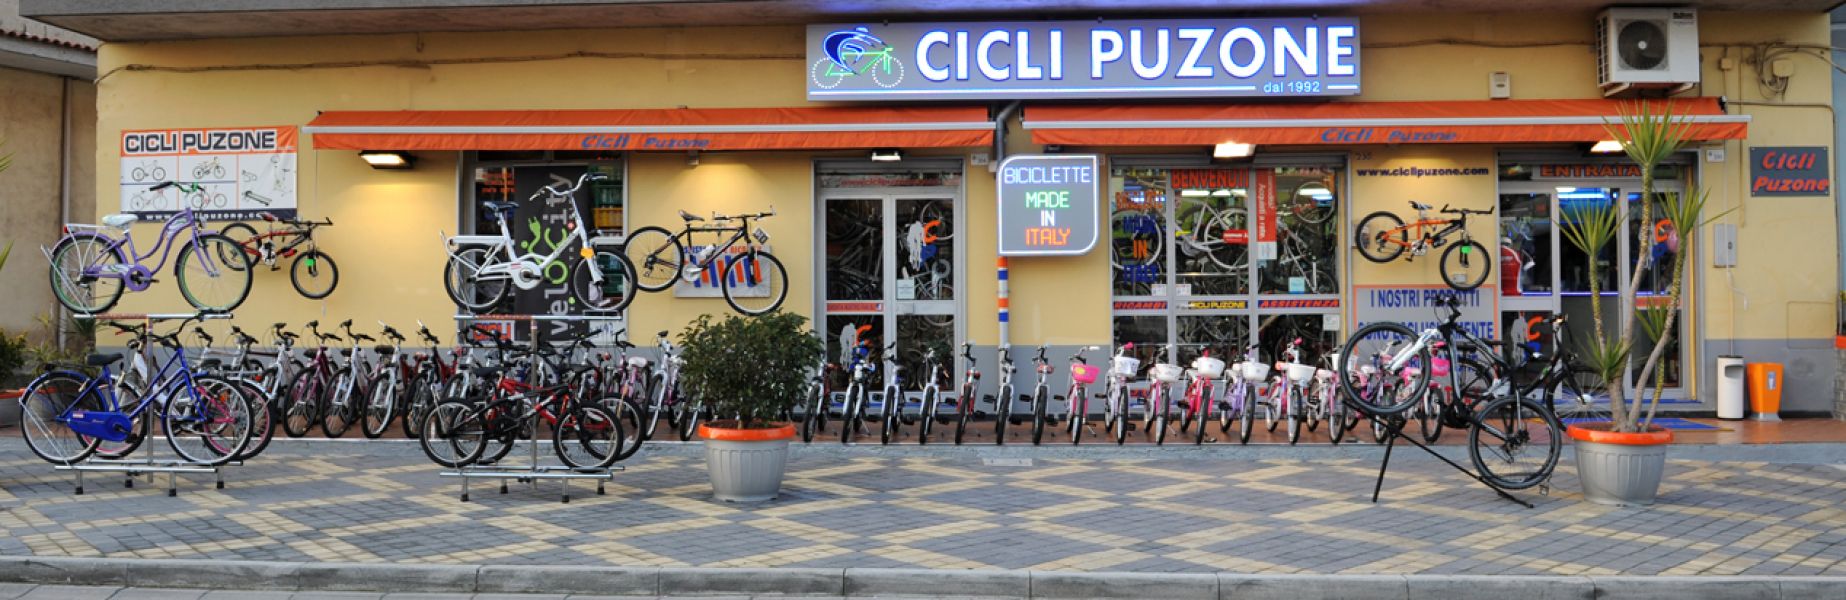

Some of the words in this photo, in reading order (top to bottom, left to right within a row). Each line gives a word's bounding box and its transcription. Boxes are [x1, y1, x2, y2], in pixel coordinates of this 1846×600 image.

[915, 29, 1063, 81] CICLI
[1090, 26, 1355, 80] PUZONE
[1263, 81, 1284, 93] dal
[1287, 81, 1320, 93] 1992
[125, 133, 177, 153] CICLI
[182, 131, 276, 151] PUZONE
[581, 134, 631, 148] Cicli
[643, 136, 710, 148] Puzone
[1321, 127, 1374, 142] Cicli
[1387, 129, 1457, 142] Puzone
[1761, 151, 1817, 170] Cicli
[1004, 166, 1092, 184] BICICLETTE
[1356, 166, 1489, 178] www.ciclipuzone.com
[1540, 162, 1643, 177] ENTRATA
[1753, 175, 1830, 192] Puzone
[1025, 191, 1071, 208] MADE
[1040, 209, 1056, 227] IN
[1025, 227, 1072, 246] ITALY
[1378, 289, 1420, 308] NOSTRI
